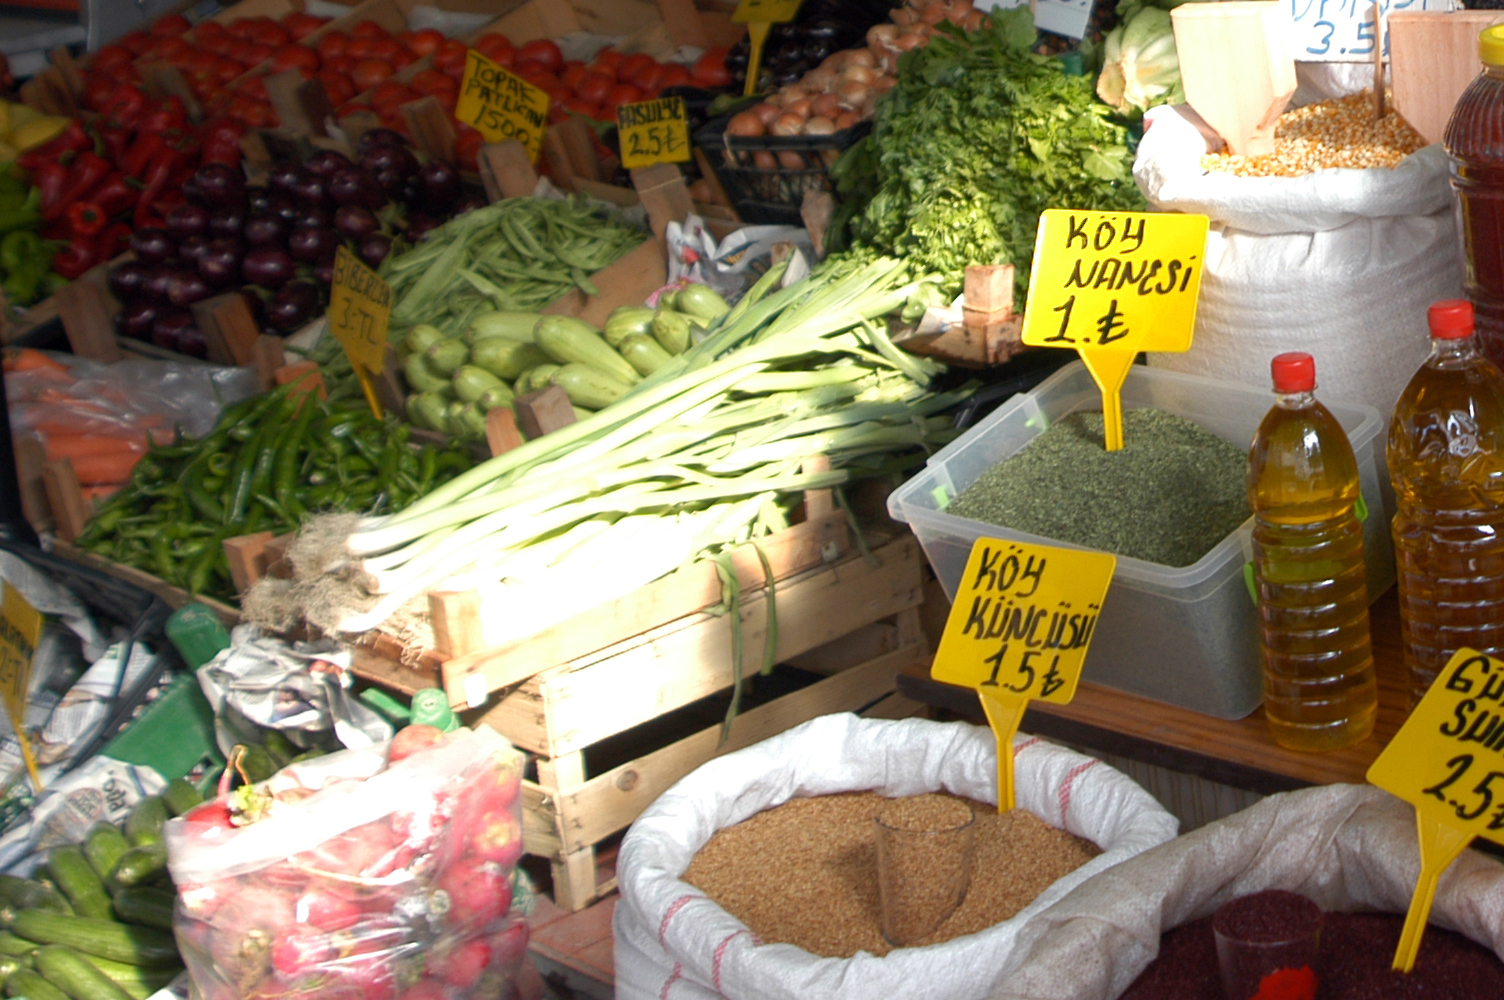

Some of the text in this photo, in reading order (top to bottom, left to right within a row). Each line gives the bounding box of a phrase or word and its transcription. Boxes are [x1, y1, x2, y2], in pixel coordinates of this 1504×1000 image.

[468, 52, 537, 105] TOPAK
[1065, 214, 1146, 255] KÖY
[972, 544, 1047, 598] KÖY
